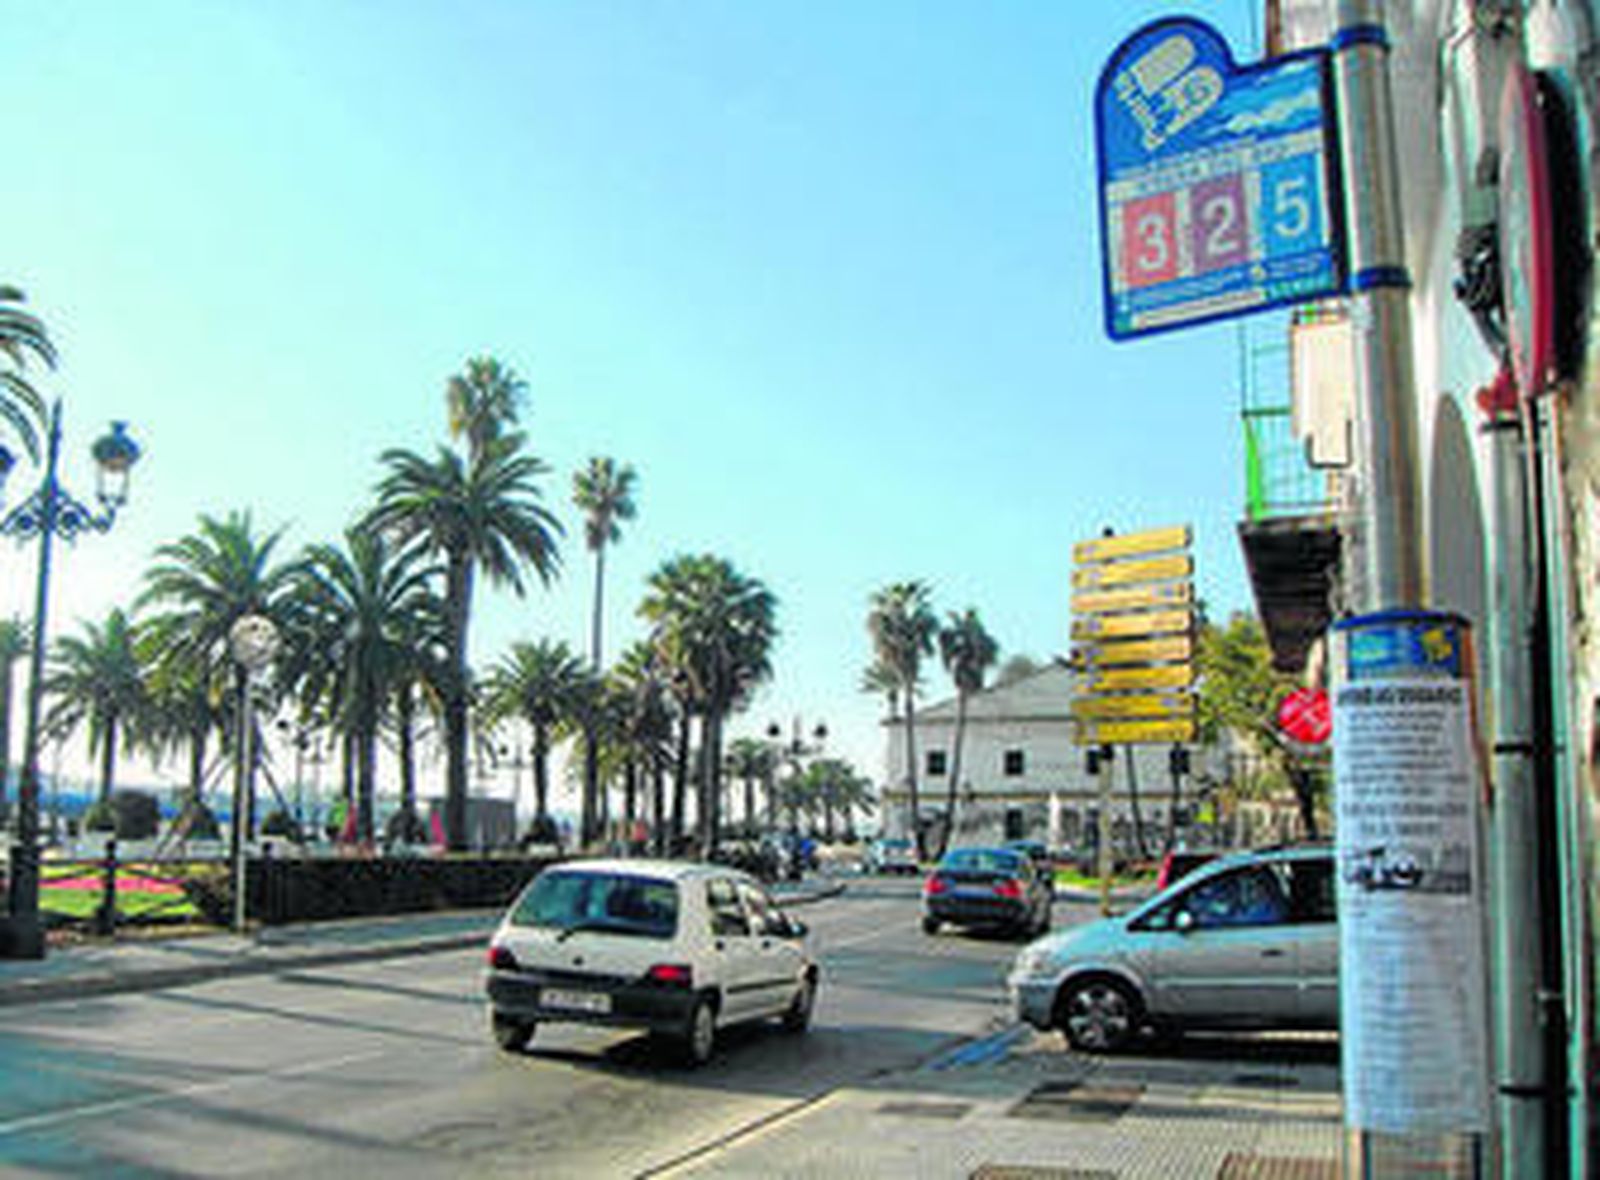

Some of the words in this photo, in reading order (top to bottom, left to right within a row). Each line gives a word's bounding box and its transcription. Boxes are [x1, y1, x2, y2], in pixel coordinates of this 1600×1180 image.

[1138, 213, 1169, 270] 3
[1202, 195, 1237, 255] 2
[1273, 179, 1308, 237] 5
